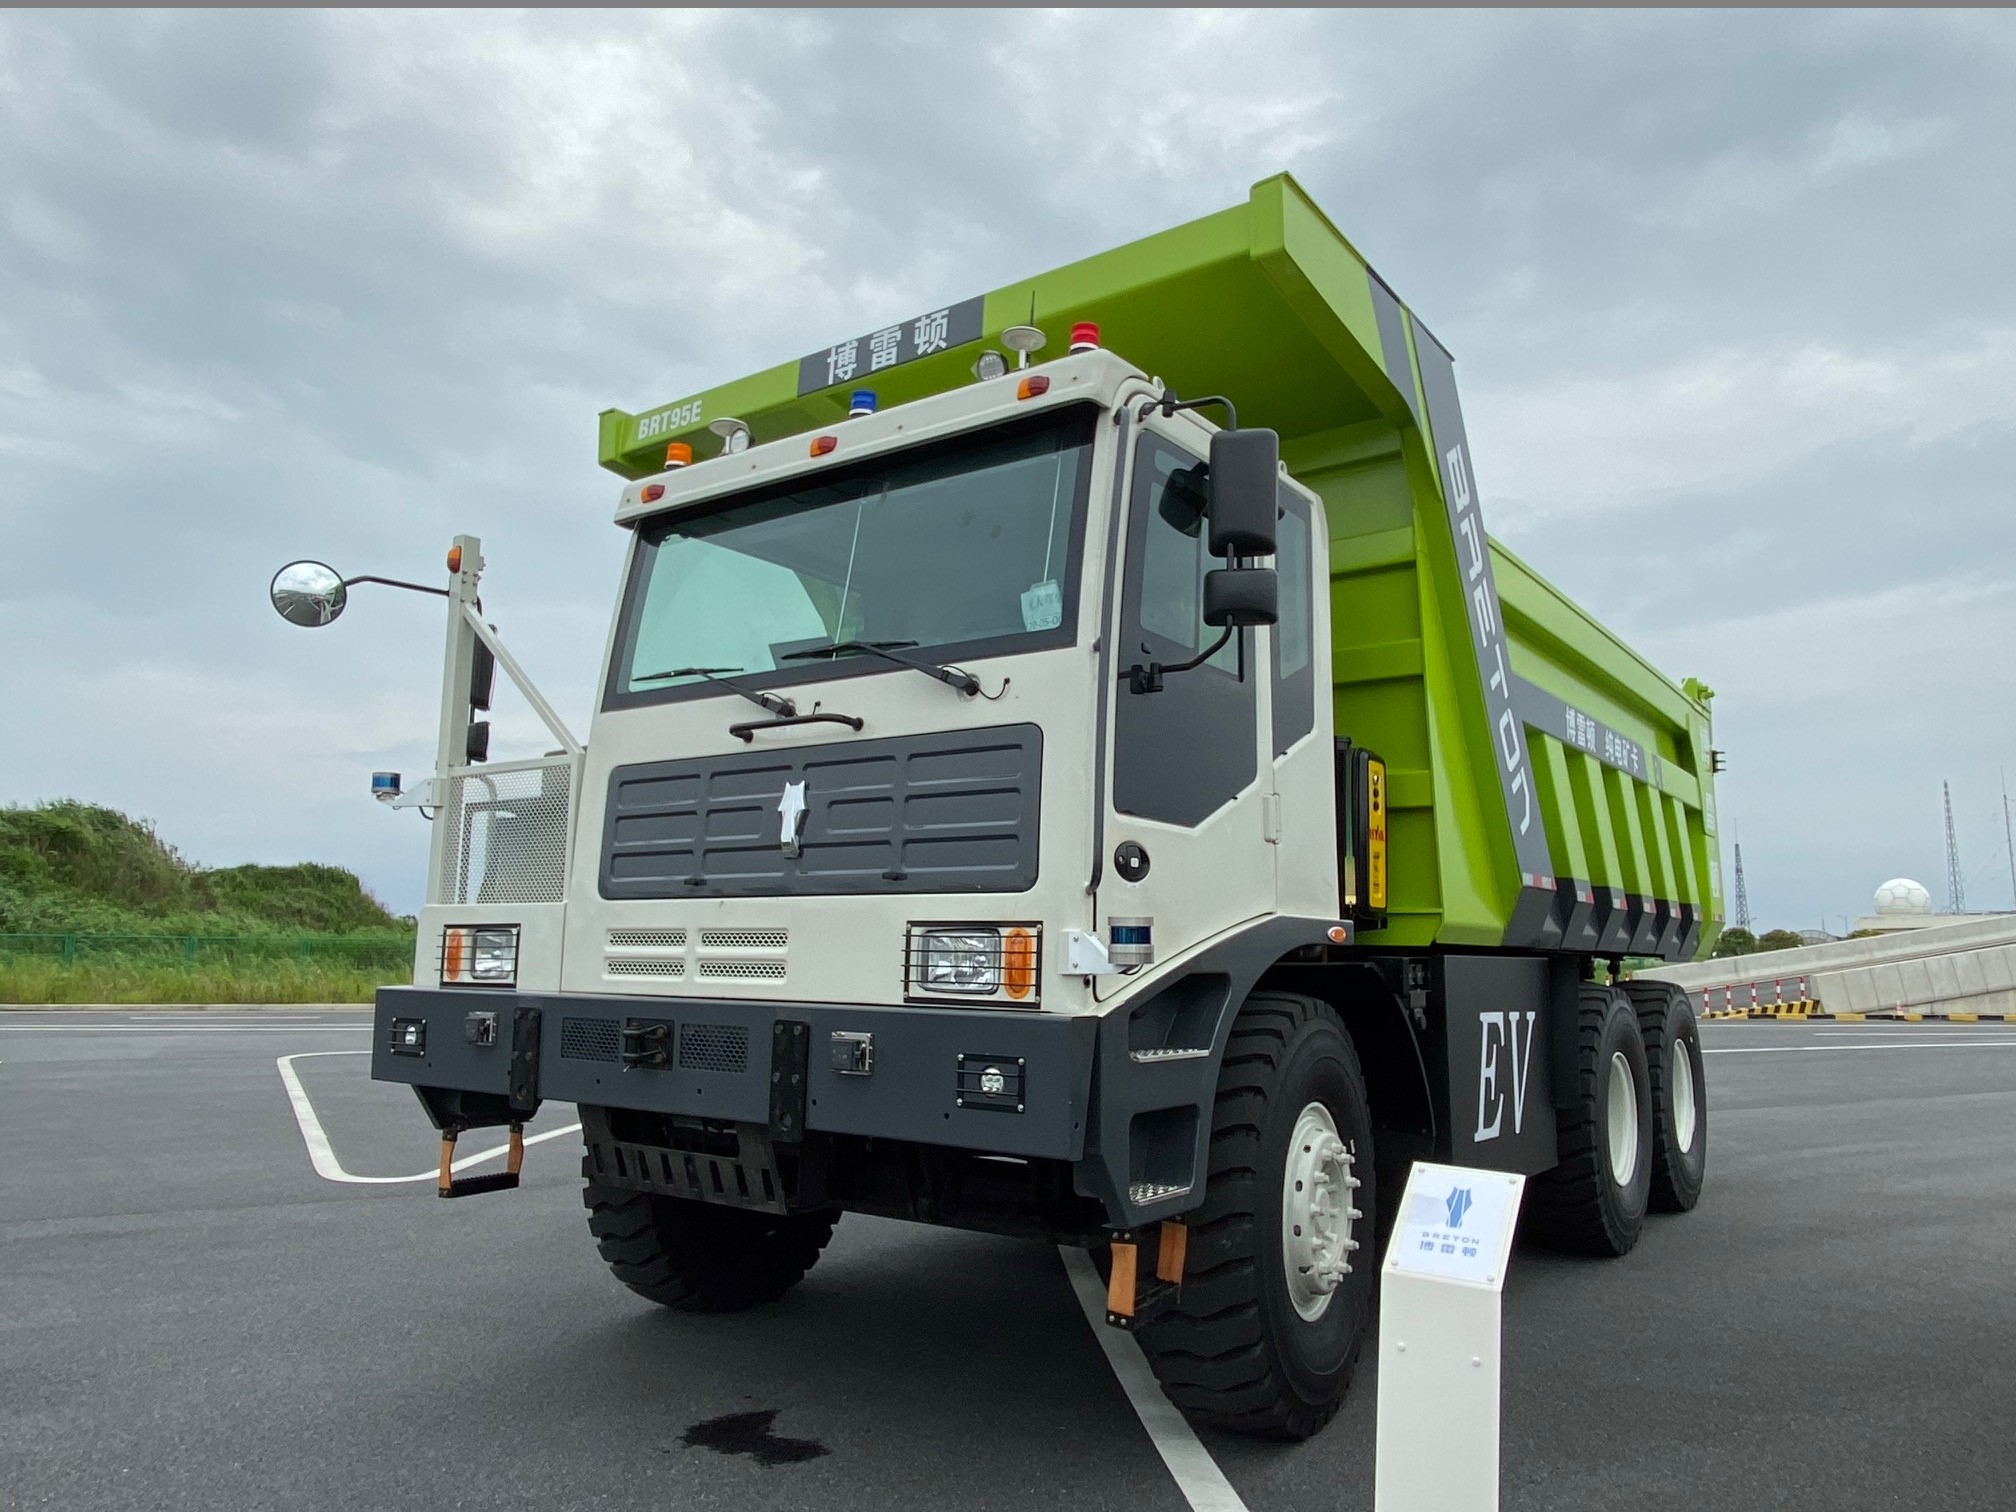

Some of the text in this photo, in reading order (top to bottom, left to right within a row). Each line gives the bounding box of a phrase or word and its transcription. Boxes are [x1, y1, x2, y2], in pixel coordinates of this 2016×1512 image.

[827, 308, 950, 386] 博雷顿
[637, 399, 703, 440] BRT95E
[1473, 1011, 1536, 1143] EV
[1422, 1231, 1480, 1245] BRETON
